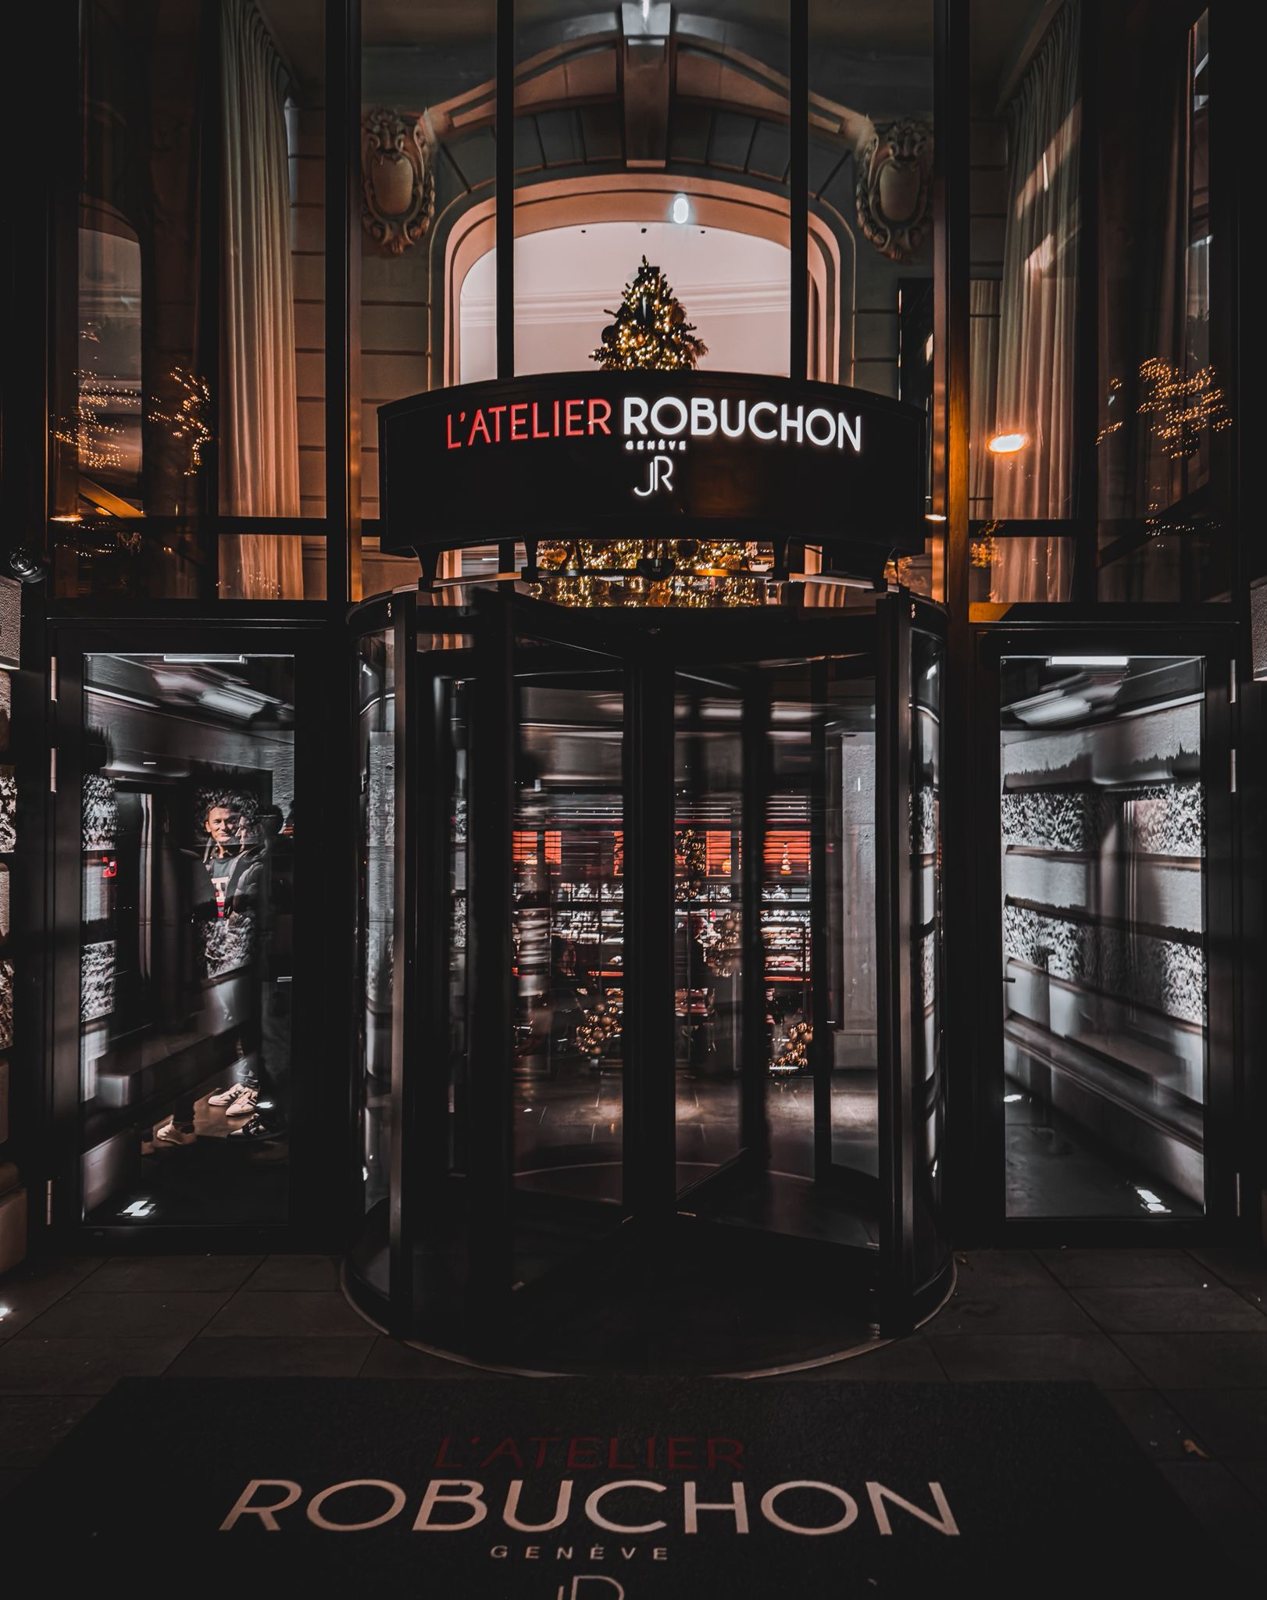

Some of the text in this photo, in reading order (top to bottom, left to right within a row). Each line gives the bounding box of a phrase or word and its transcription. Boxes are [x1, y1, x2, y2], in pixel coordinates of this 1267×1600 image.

[446, 397, 861, 452] L'ATELIER ROBUCHON
[432, 1436, 746, 1470] L'ATELIER
[220, 1480, 959, 1535] ROBUCHON
